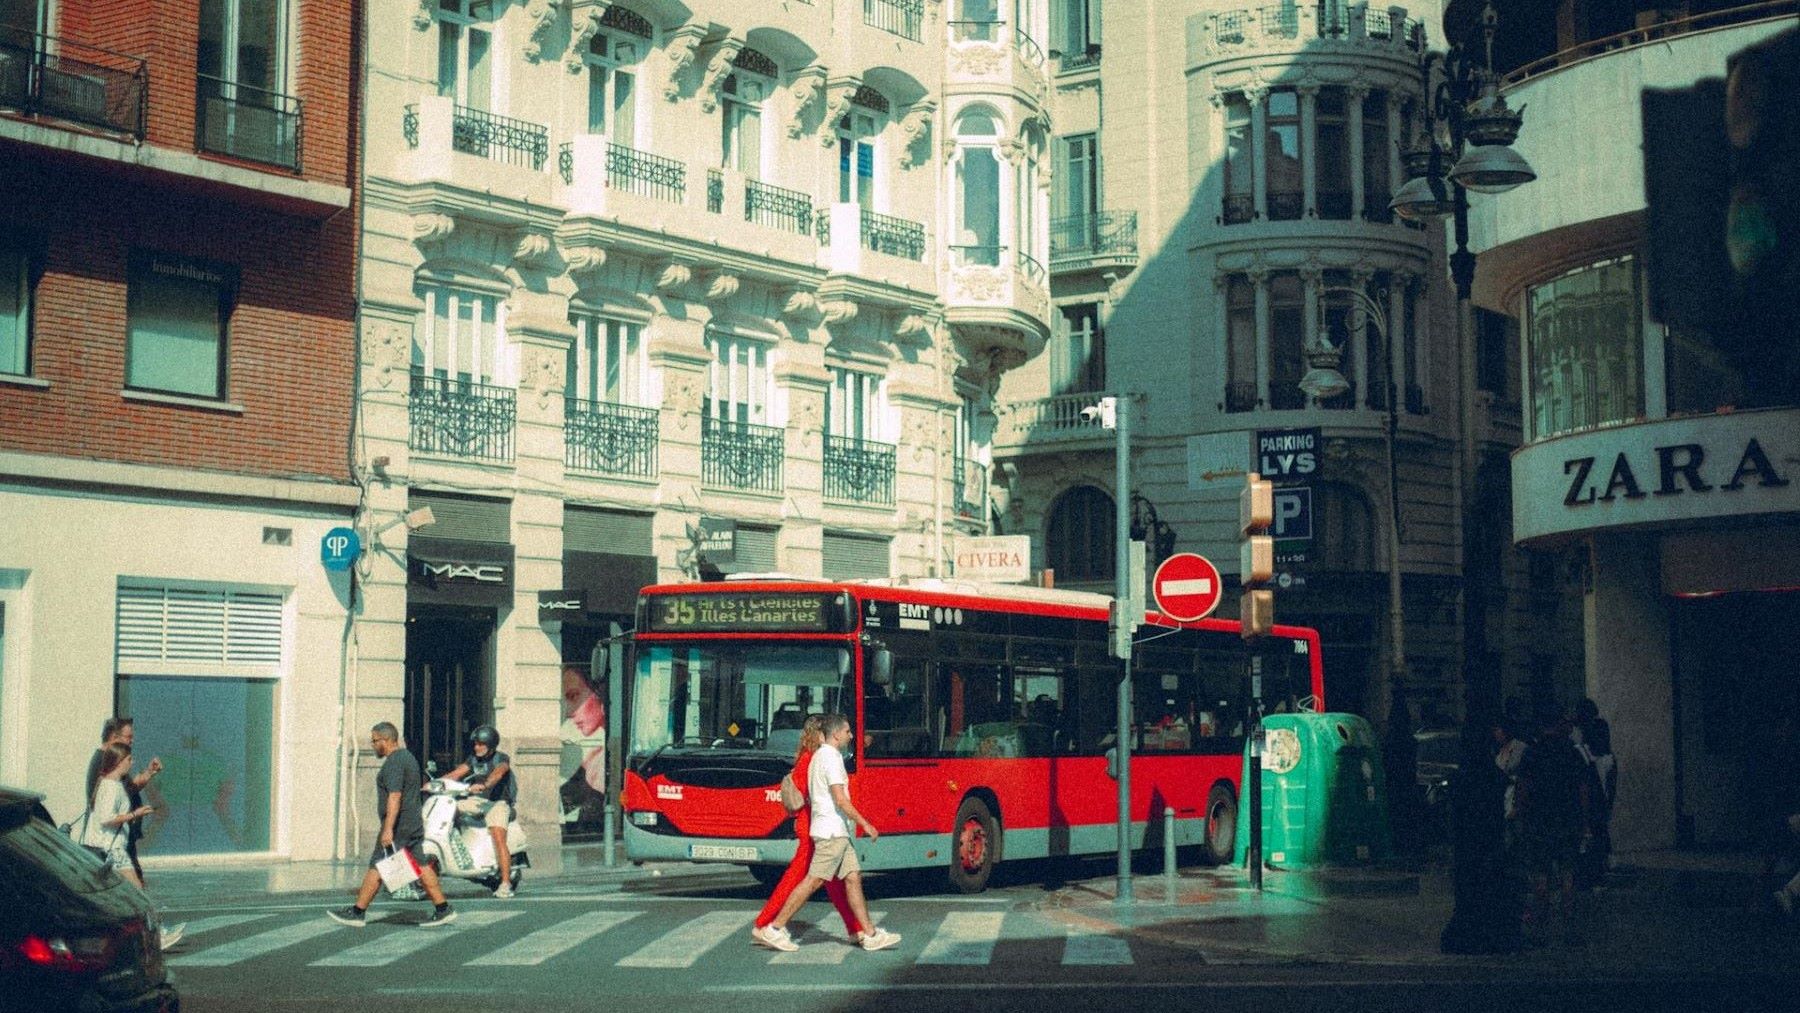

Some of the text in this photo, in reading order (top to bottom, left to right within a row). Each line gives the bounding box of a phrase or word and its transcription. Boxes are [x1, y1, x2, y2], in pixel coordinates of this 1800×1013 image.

[1260, 434, 1314, 452] PARKING
[1261, 453, 1316, 476] LYS
[1563, 437, 1790, 506] ZARA
[1275, 494, 1302, 535] P
[957, 552, 1022, 568] CIVERA
[423, 563, 504, 582] MAC
[538, 600, 581, 610] MAC
[663, 597, 696, 624] 35
[899, 603, 930, 619] EMT
[700, 609, 817, 623] Illes Canaries
[657, 784, 683, 794] EMT
[765, 789, 783, 801] 706
